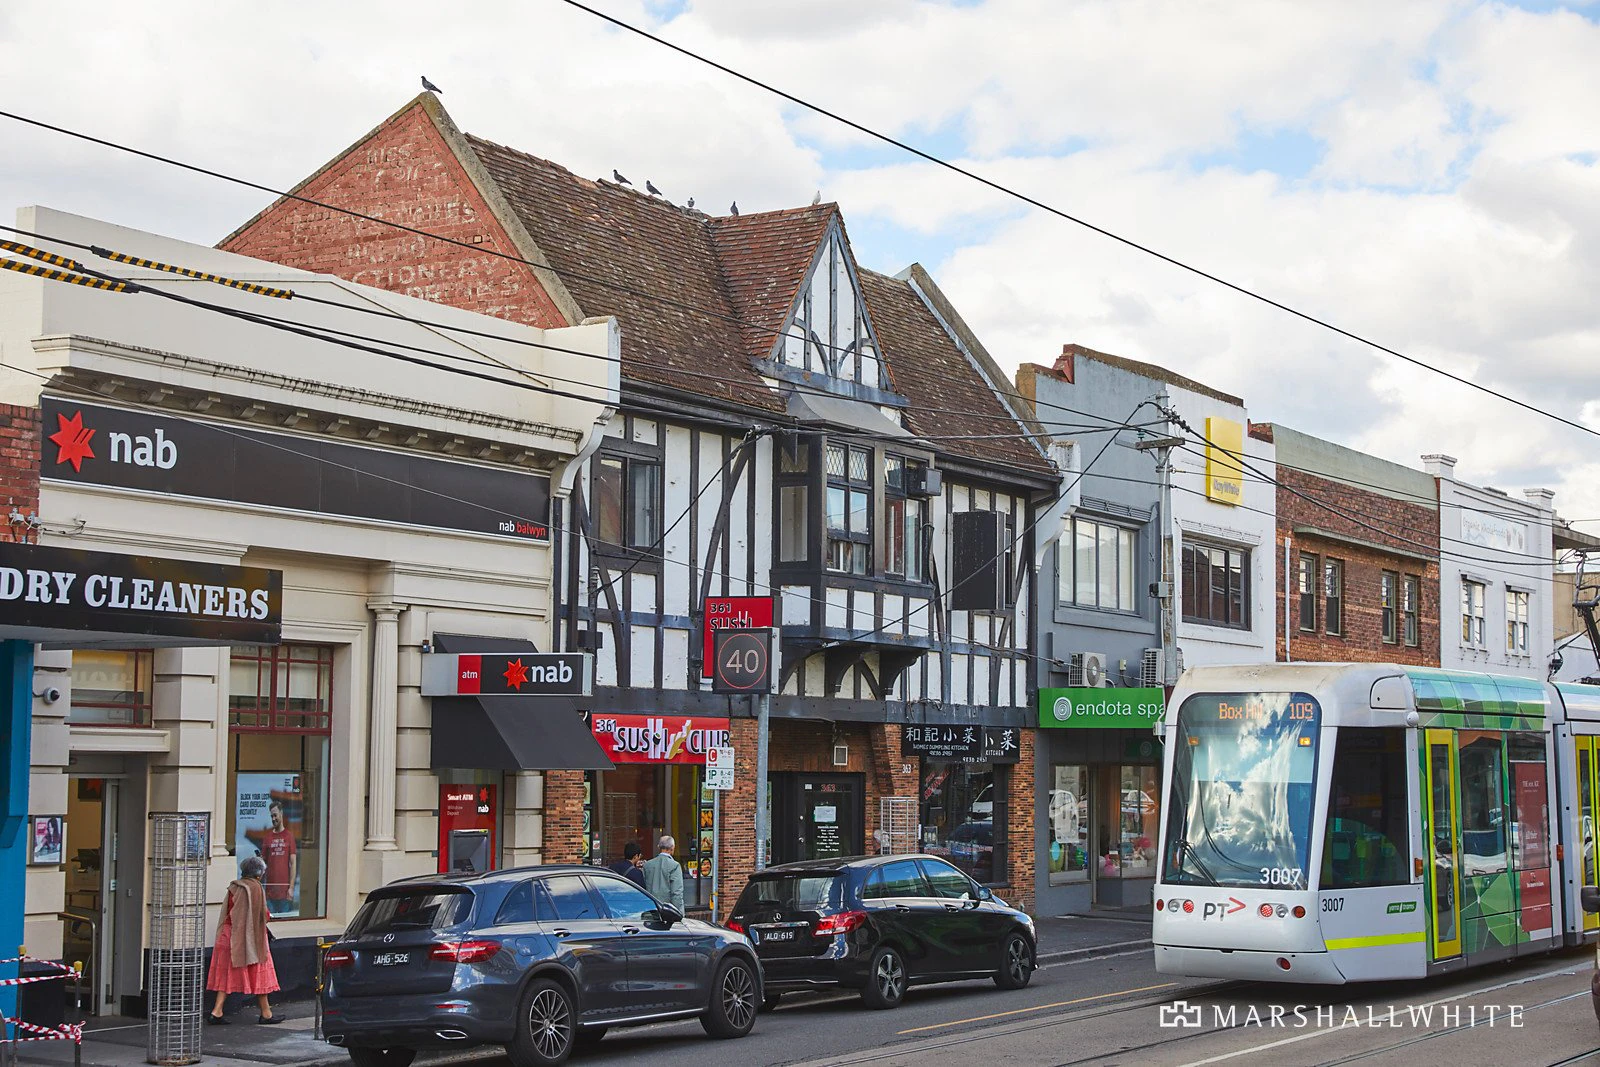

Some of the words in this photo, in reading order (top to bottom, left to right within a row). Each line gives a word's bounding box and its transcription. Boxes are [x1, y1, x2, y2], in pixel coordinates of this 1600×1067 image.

[109, 429, 177, 469] nab
[500, 520, 515, 532] nab
[516, 521, 546, 538] balwyn
[0, 567, 76, 604] DRY
[84, 574, 269, 620] CLEANERS
[710, 603, 732, 613] 361
[726, 650, 759, 674] 40
[462, 670, 478, 679] atm
[531, 660, 573, 683] nab
[1076, 700, 1131, 716] endota
[1219, 702, 1242, 719] Box
[1245, 702, 1263, 719] Hill
[1289, 702, 1313, 720] 109
[597, 719, 616, 732] 361
[906, 726, 977, 744] 和記小菜
[902, 763, 912, 774] 363
[477, 804, 490, 813] nab
[1260, 867, 1302, 885] 3007
[1321, 898, 1345, 912] 3007
